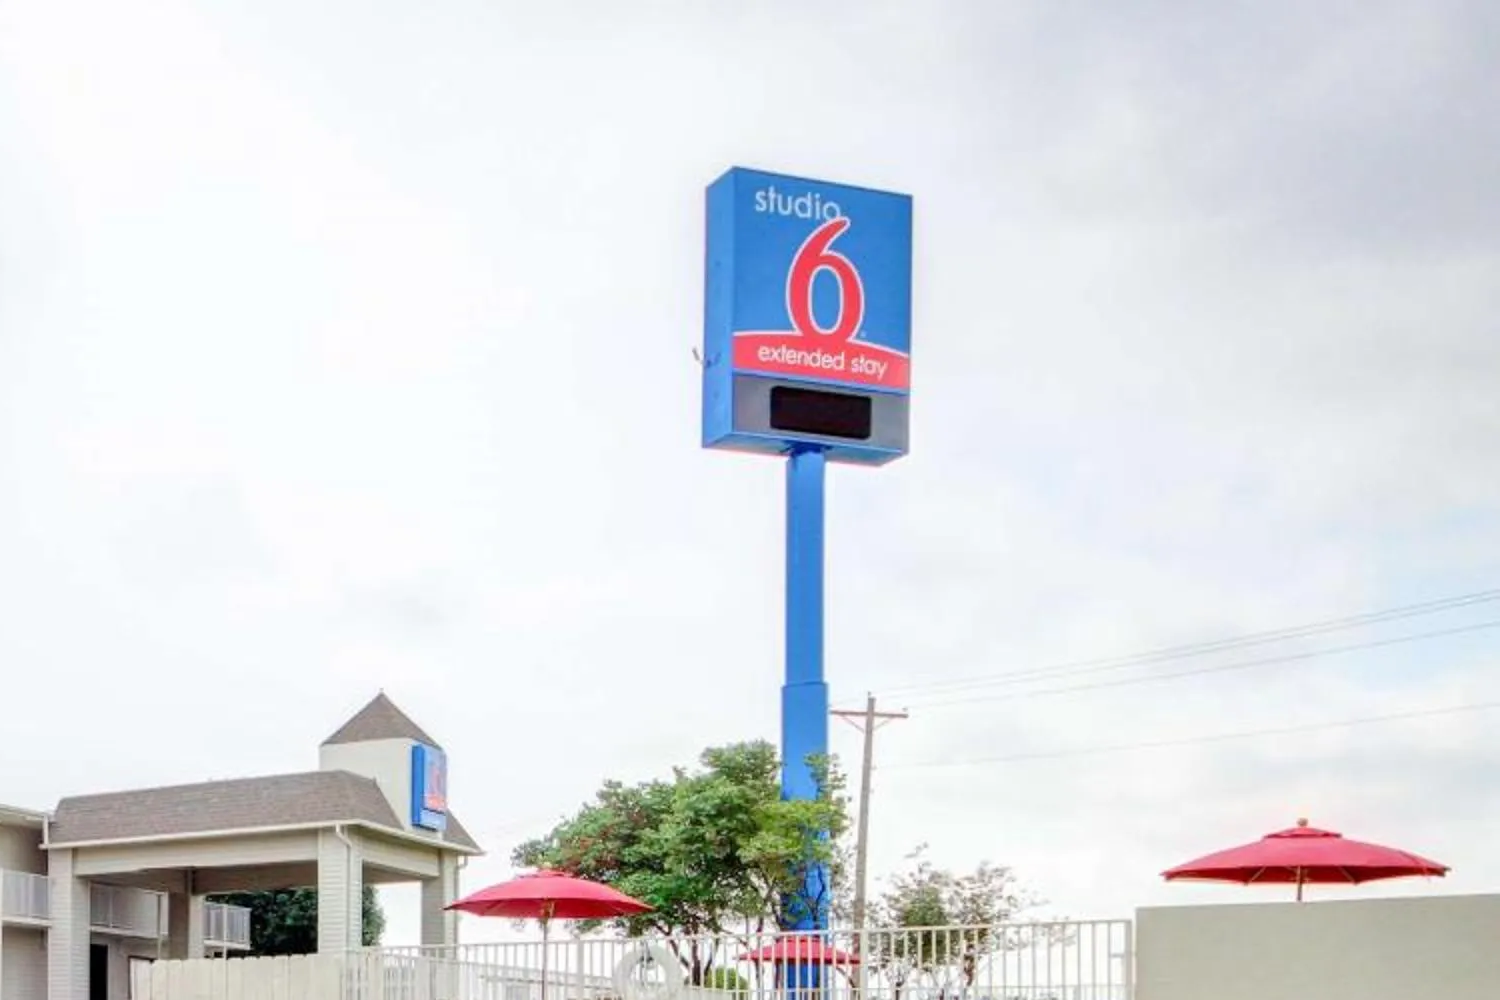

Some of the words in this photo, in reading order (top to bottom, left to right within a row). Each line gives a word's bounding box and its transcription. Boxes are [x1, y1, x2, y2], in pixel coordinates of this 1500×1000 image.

[755, 186, 841, 220] studio
[786, 216, 865, 341] 6
[757, 344, 845, 370] extended
[850, 356, 888, 380] stay
